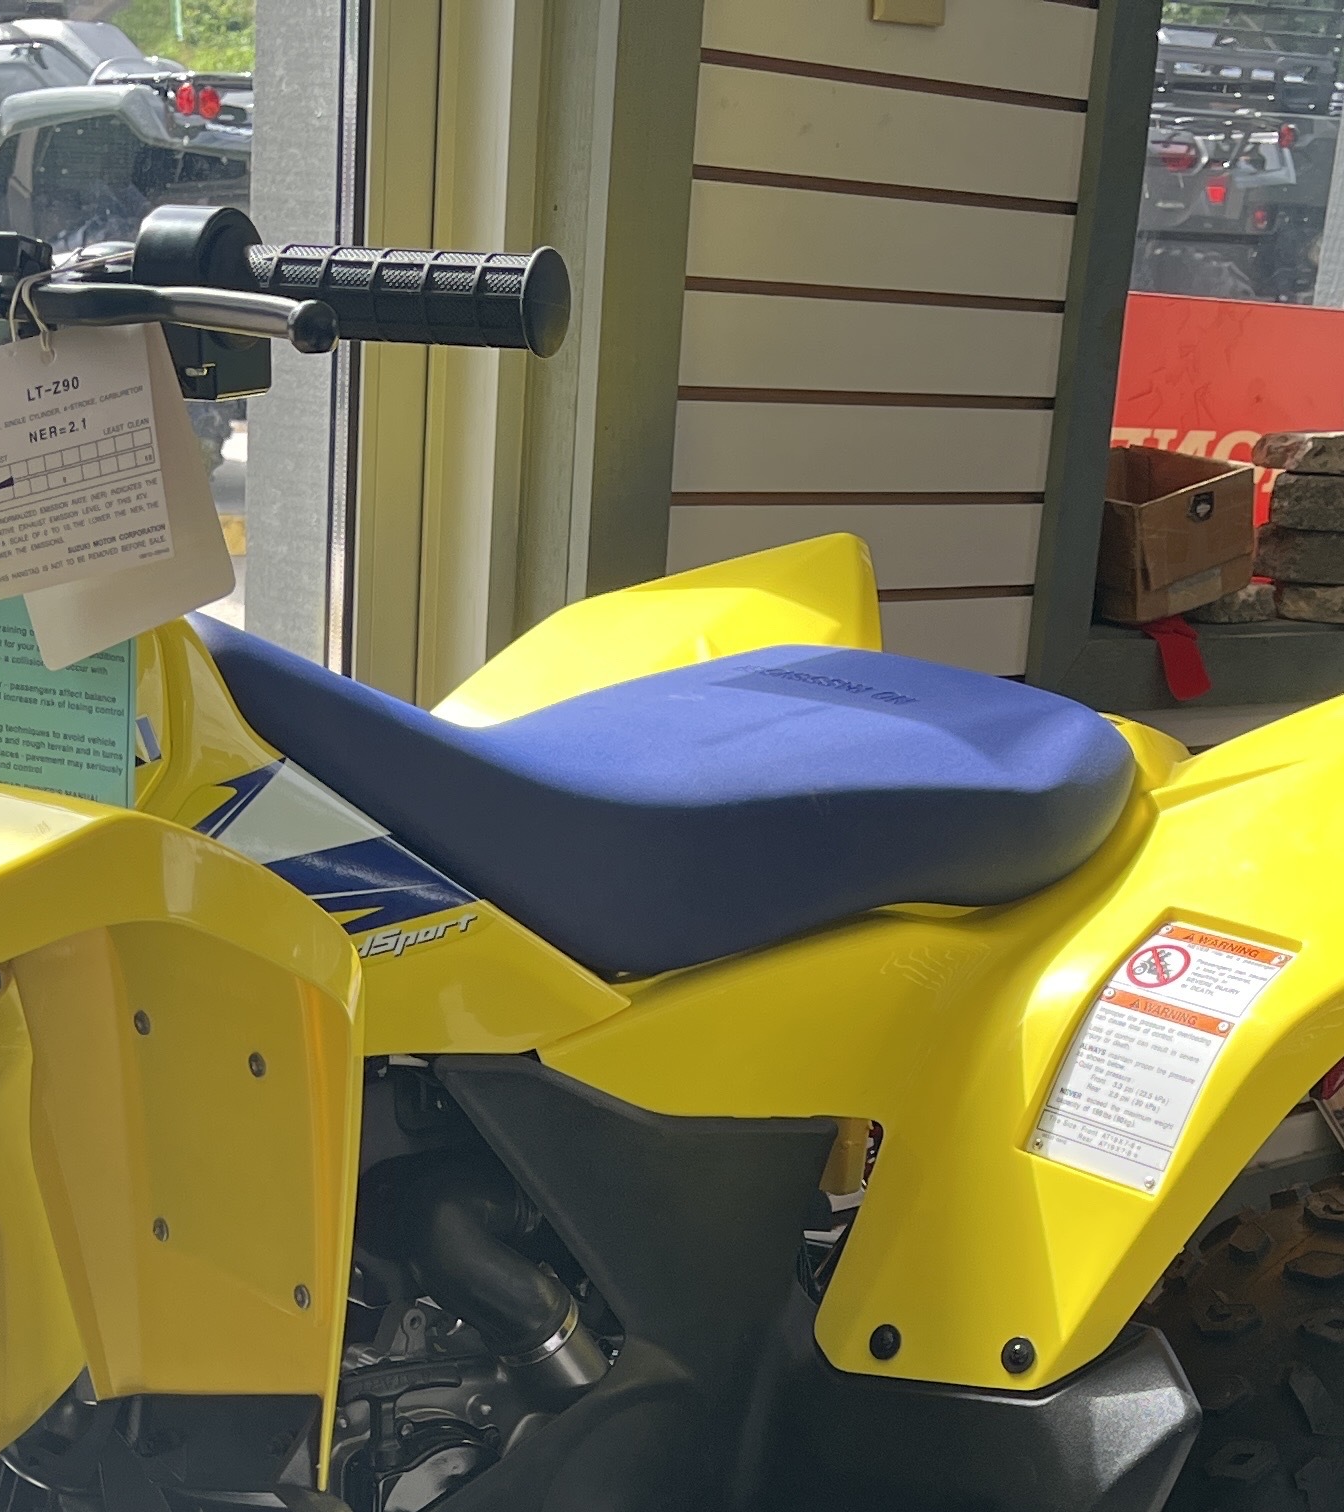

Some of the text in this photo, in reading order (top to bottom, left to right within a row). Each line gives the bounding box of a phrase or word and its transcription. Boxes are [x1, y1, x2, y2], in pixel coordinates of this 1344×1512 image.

[27, 376, 80, 401] LT-Z90
[103, 418, 150, 436] LEAST CLEAN
[93, 536, 116, 547] MOTOR
[119, 523, 166, 541] CORPORATION
[17, 643, 34, 651] your
[95, 706, 125, 717] control
[86, 761, 123, 776] seriously
[1198, 934, 1260, 959] WARNING
[1144, 1000, 1198, 1026] WARNING
